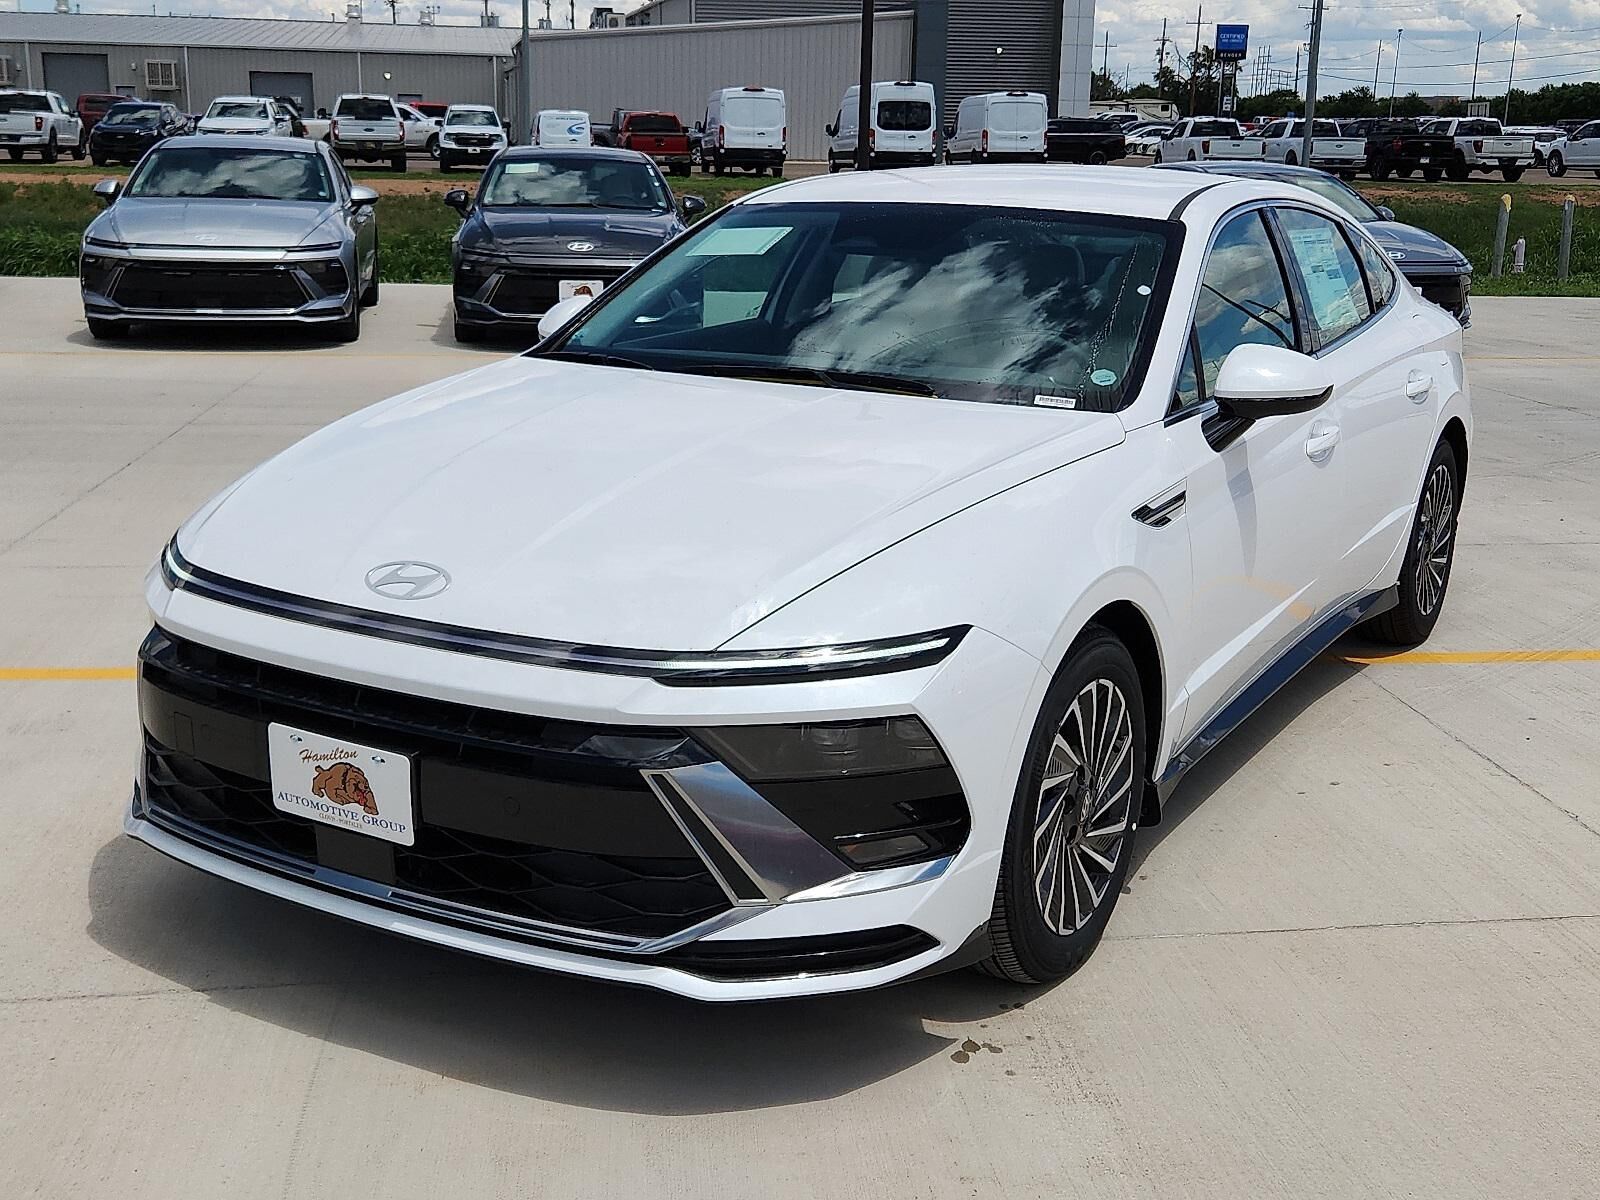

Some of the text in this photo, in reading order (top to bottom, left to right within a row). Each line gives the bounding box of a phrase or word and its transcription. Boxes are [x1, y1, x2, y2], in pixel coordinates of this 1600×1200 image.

[299, 747, 358, 763] Hamilton
[278, 791, 359, 821] AUTOMOTIVE
[361, 814, 406, 833] GROUP
